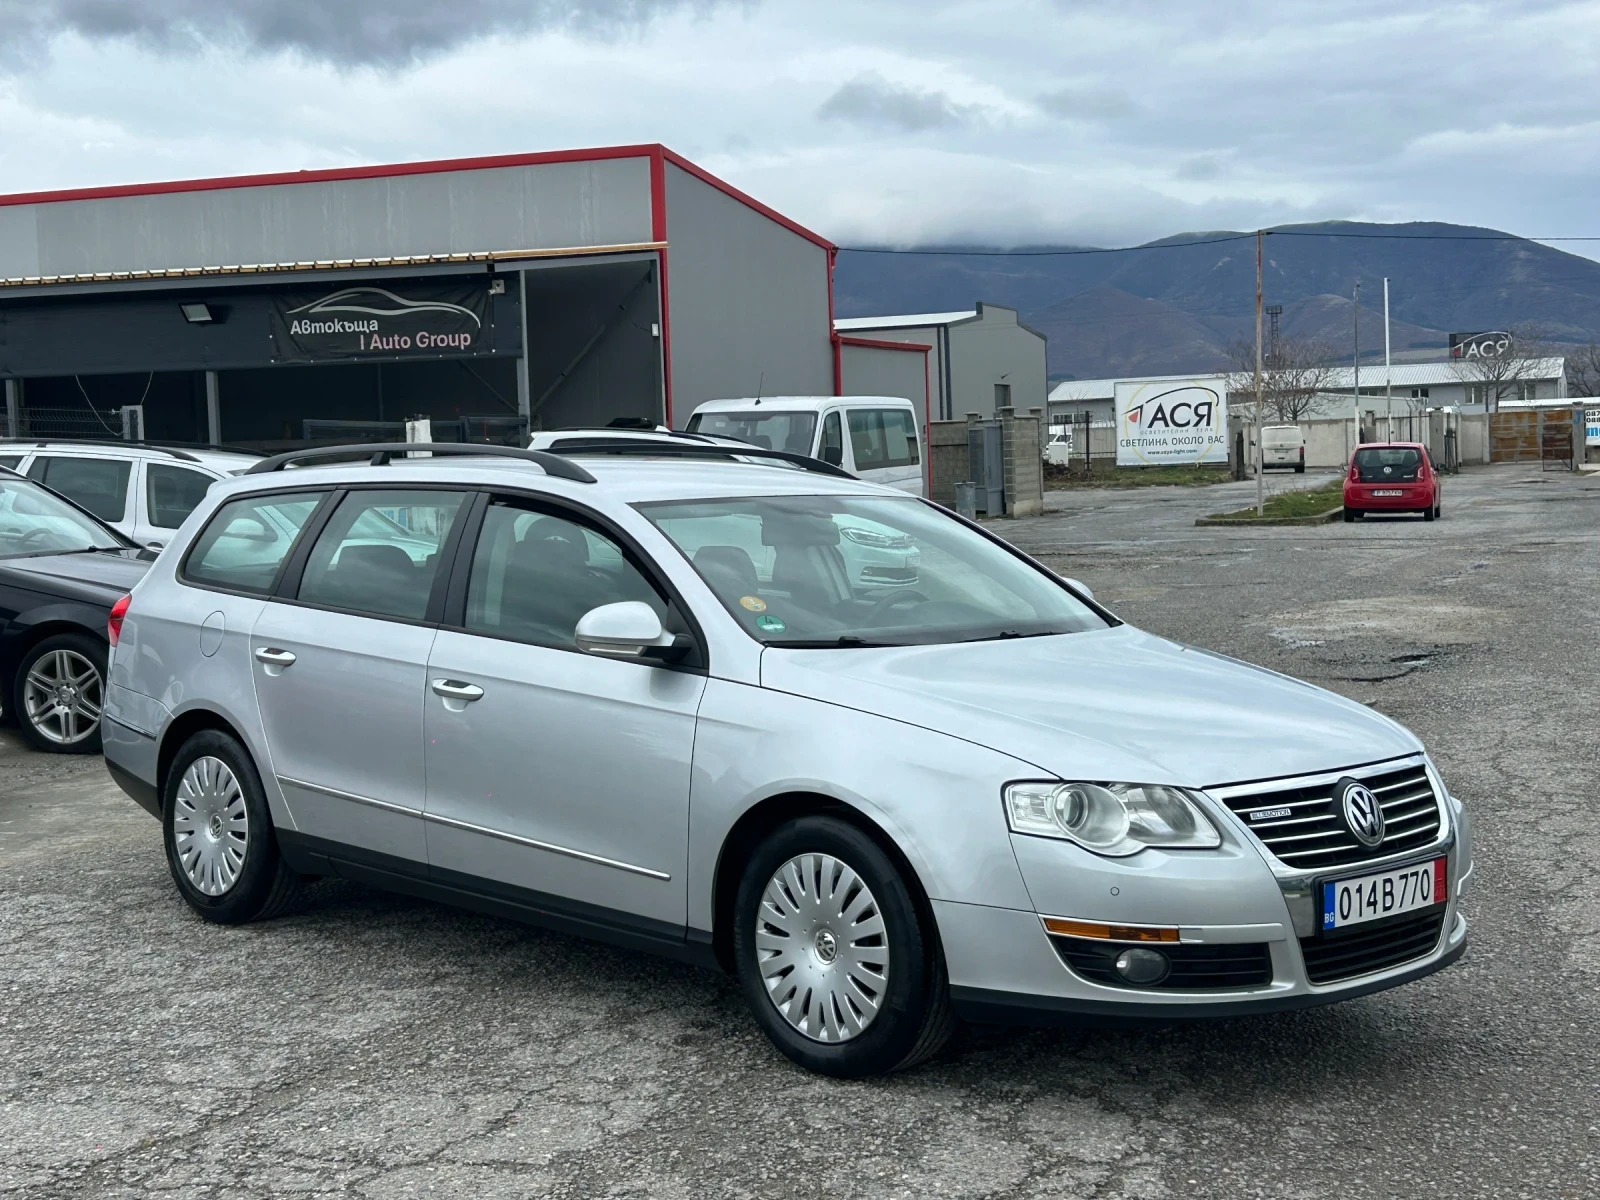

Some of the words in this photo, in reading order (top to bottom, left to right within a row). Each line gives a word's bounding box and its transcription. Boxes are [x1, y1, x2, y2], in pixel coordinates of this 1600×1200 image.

[290, 318, 379, 334] Автокъща
[370, 333, 411, 350] Auto
[415, 331, 471, 350] Group
[1147, 401, 1213, 429] АСЯ
[1120, 438, 1168, 448] СВЕТЛИНА
[1171, 435, 1204, 446] ОКОЛО
[1208, 435, 1225, 444] ВАС
[1339, 868, 1431, 921] 014B770
[1324, 912, 1335, 923] BG
